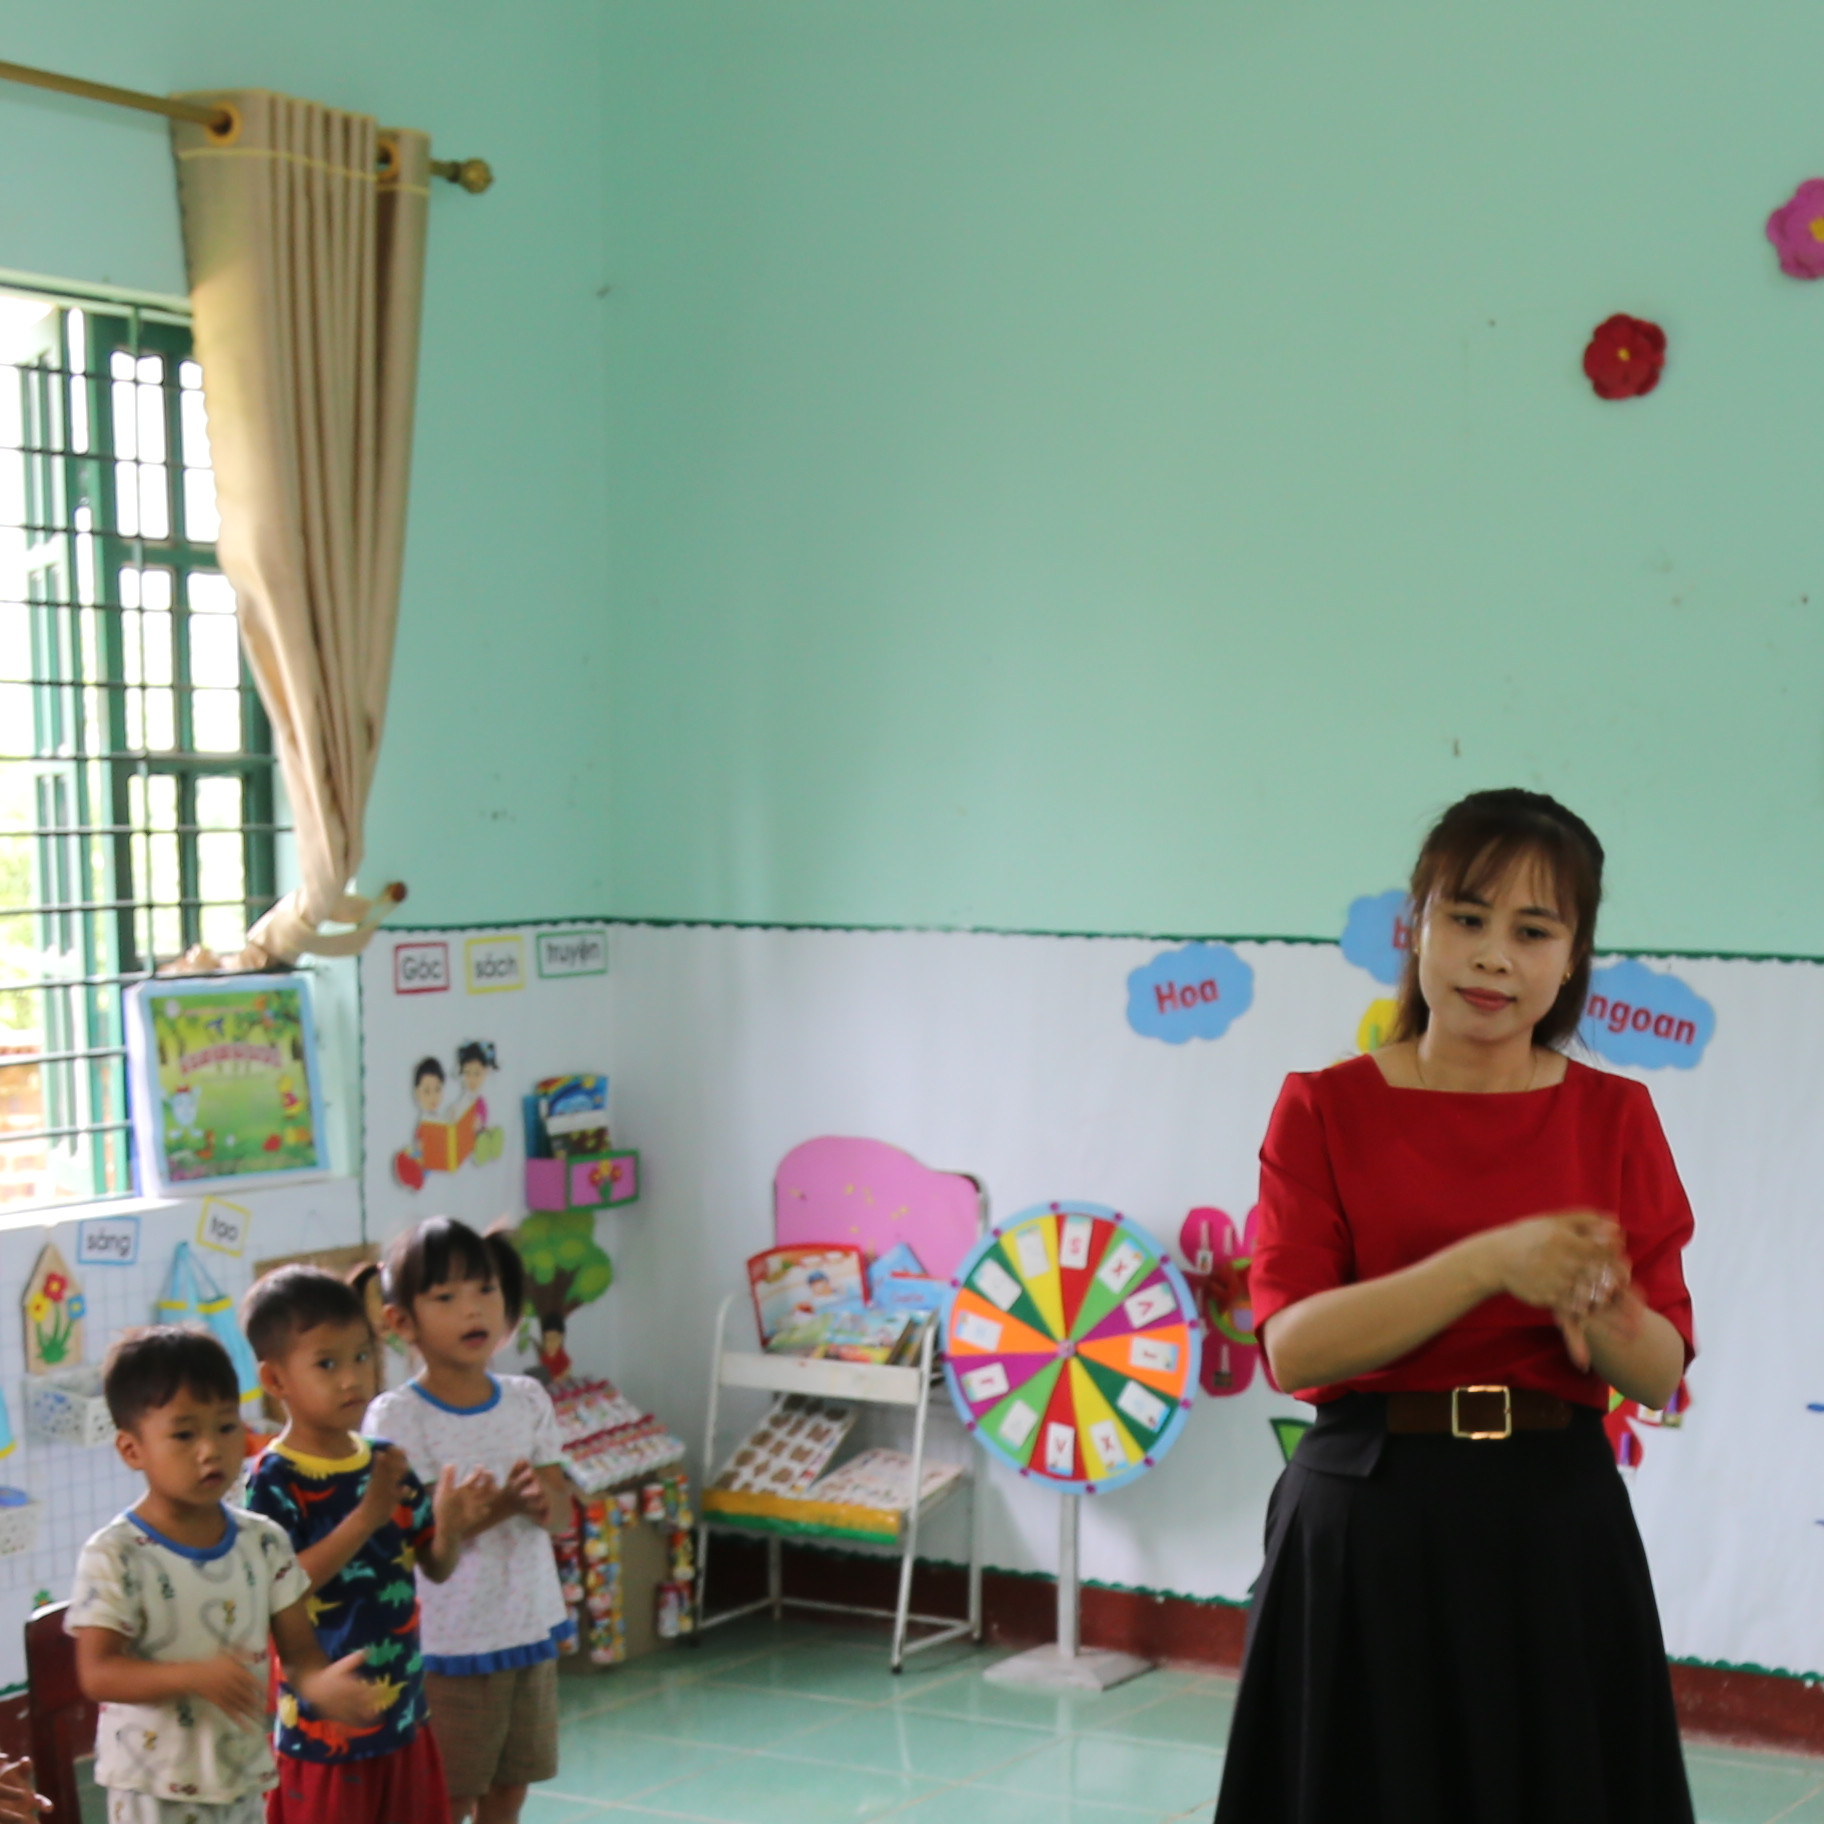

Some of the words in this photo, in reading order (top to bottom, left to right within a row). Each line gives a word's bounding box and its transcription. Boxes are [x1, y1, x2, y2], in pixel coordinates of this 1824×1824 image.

[1153, 977, 1220, 1014] Hoa
[1391, 918, 1411, 951] b
[1586, 992, 1698, 1046] ngoan
[86, 1225, 131, 1256] sáng
